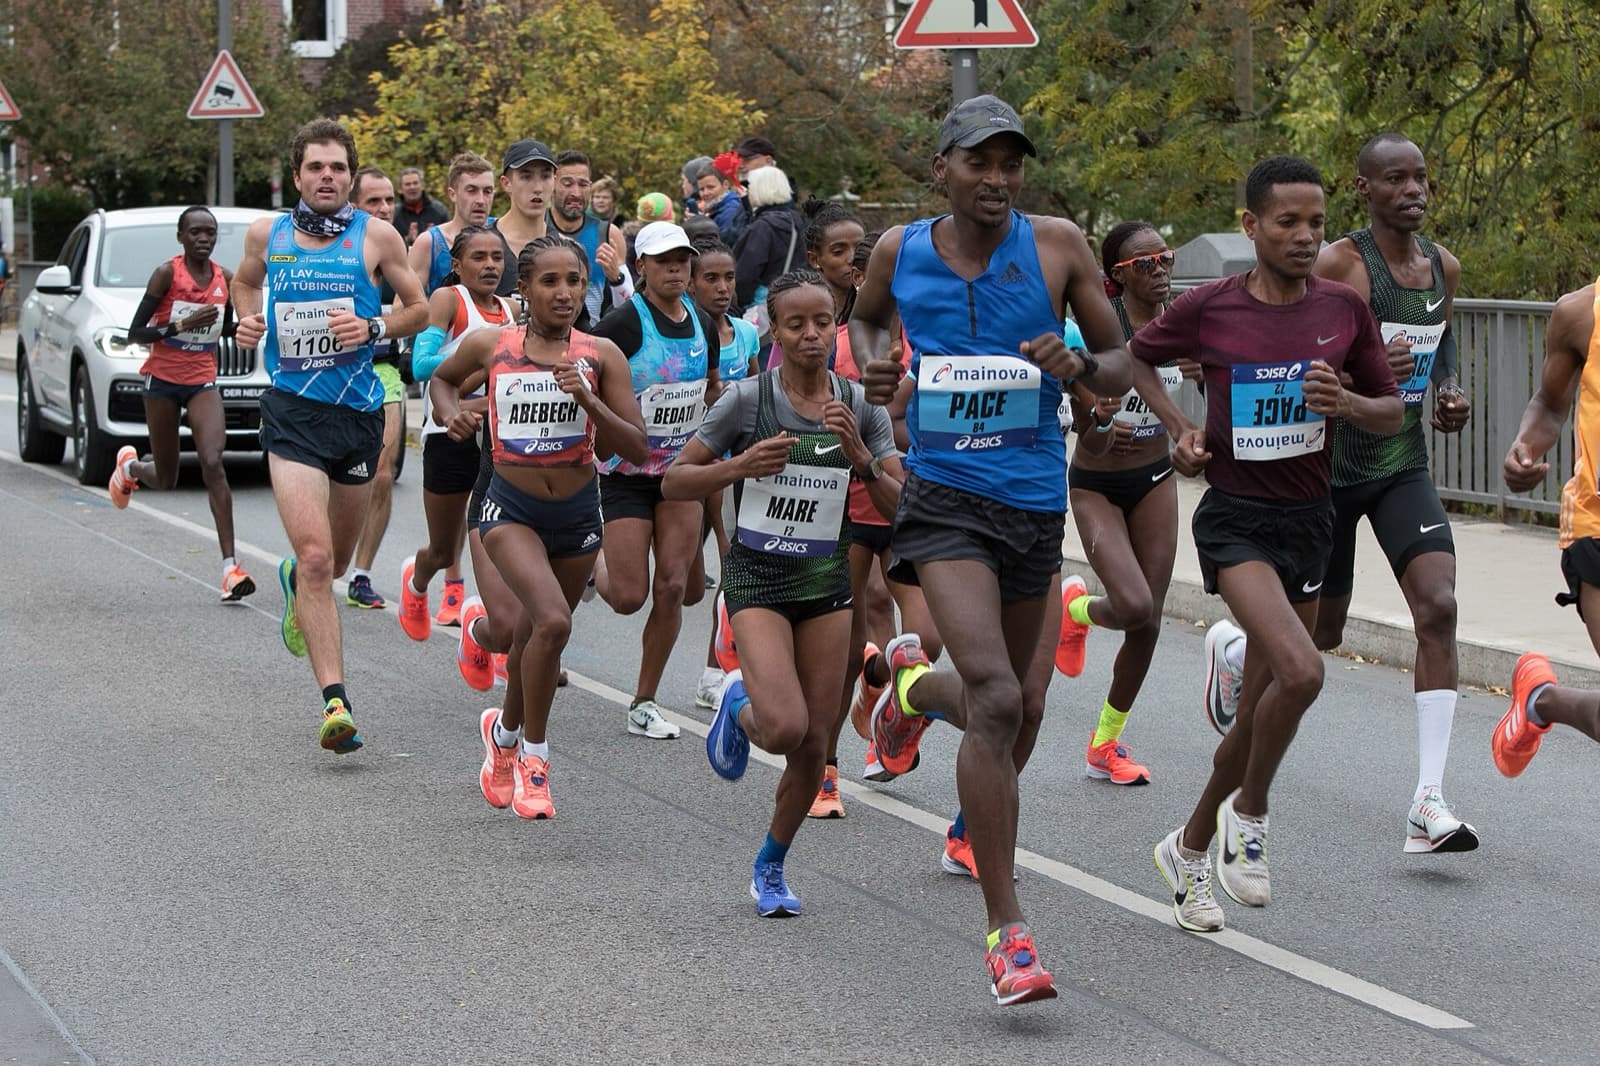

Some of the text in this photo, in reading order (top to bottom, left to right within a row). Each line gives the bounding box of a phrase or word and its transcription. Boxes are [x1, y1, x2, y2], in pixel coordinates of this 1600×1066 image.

[291, 269, 355, 281] LAV Stadtwerke
[291, 280, 355, 292] TÜBINGEN
[313, 358, 335, 368] asics
[954, 366, 1029, 381] mainova
[1256, 367, 1287, 379] asics
[523, 379, 558, 392] main
[223, 388, 266, 398] DER NEU
[949, 391, 1008, 420] PACE
[1253, 396, 1307, 426] PACE
[509, 402, 578, 424] ABEBECH
[972, 422, 985, 433] 84
[537, 441, 563, 451] asics
[970, 435, 1002, 449] asics
[1236, 432, 1304, 450] mainova
[774, 474, 838, 490] mainova
[766, 496, 819, 523] MARE
[784, 525, 795, 536] F2
[778, 540, 808, 553] asics
